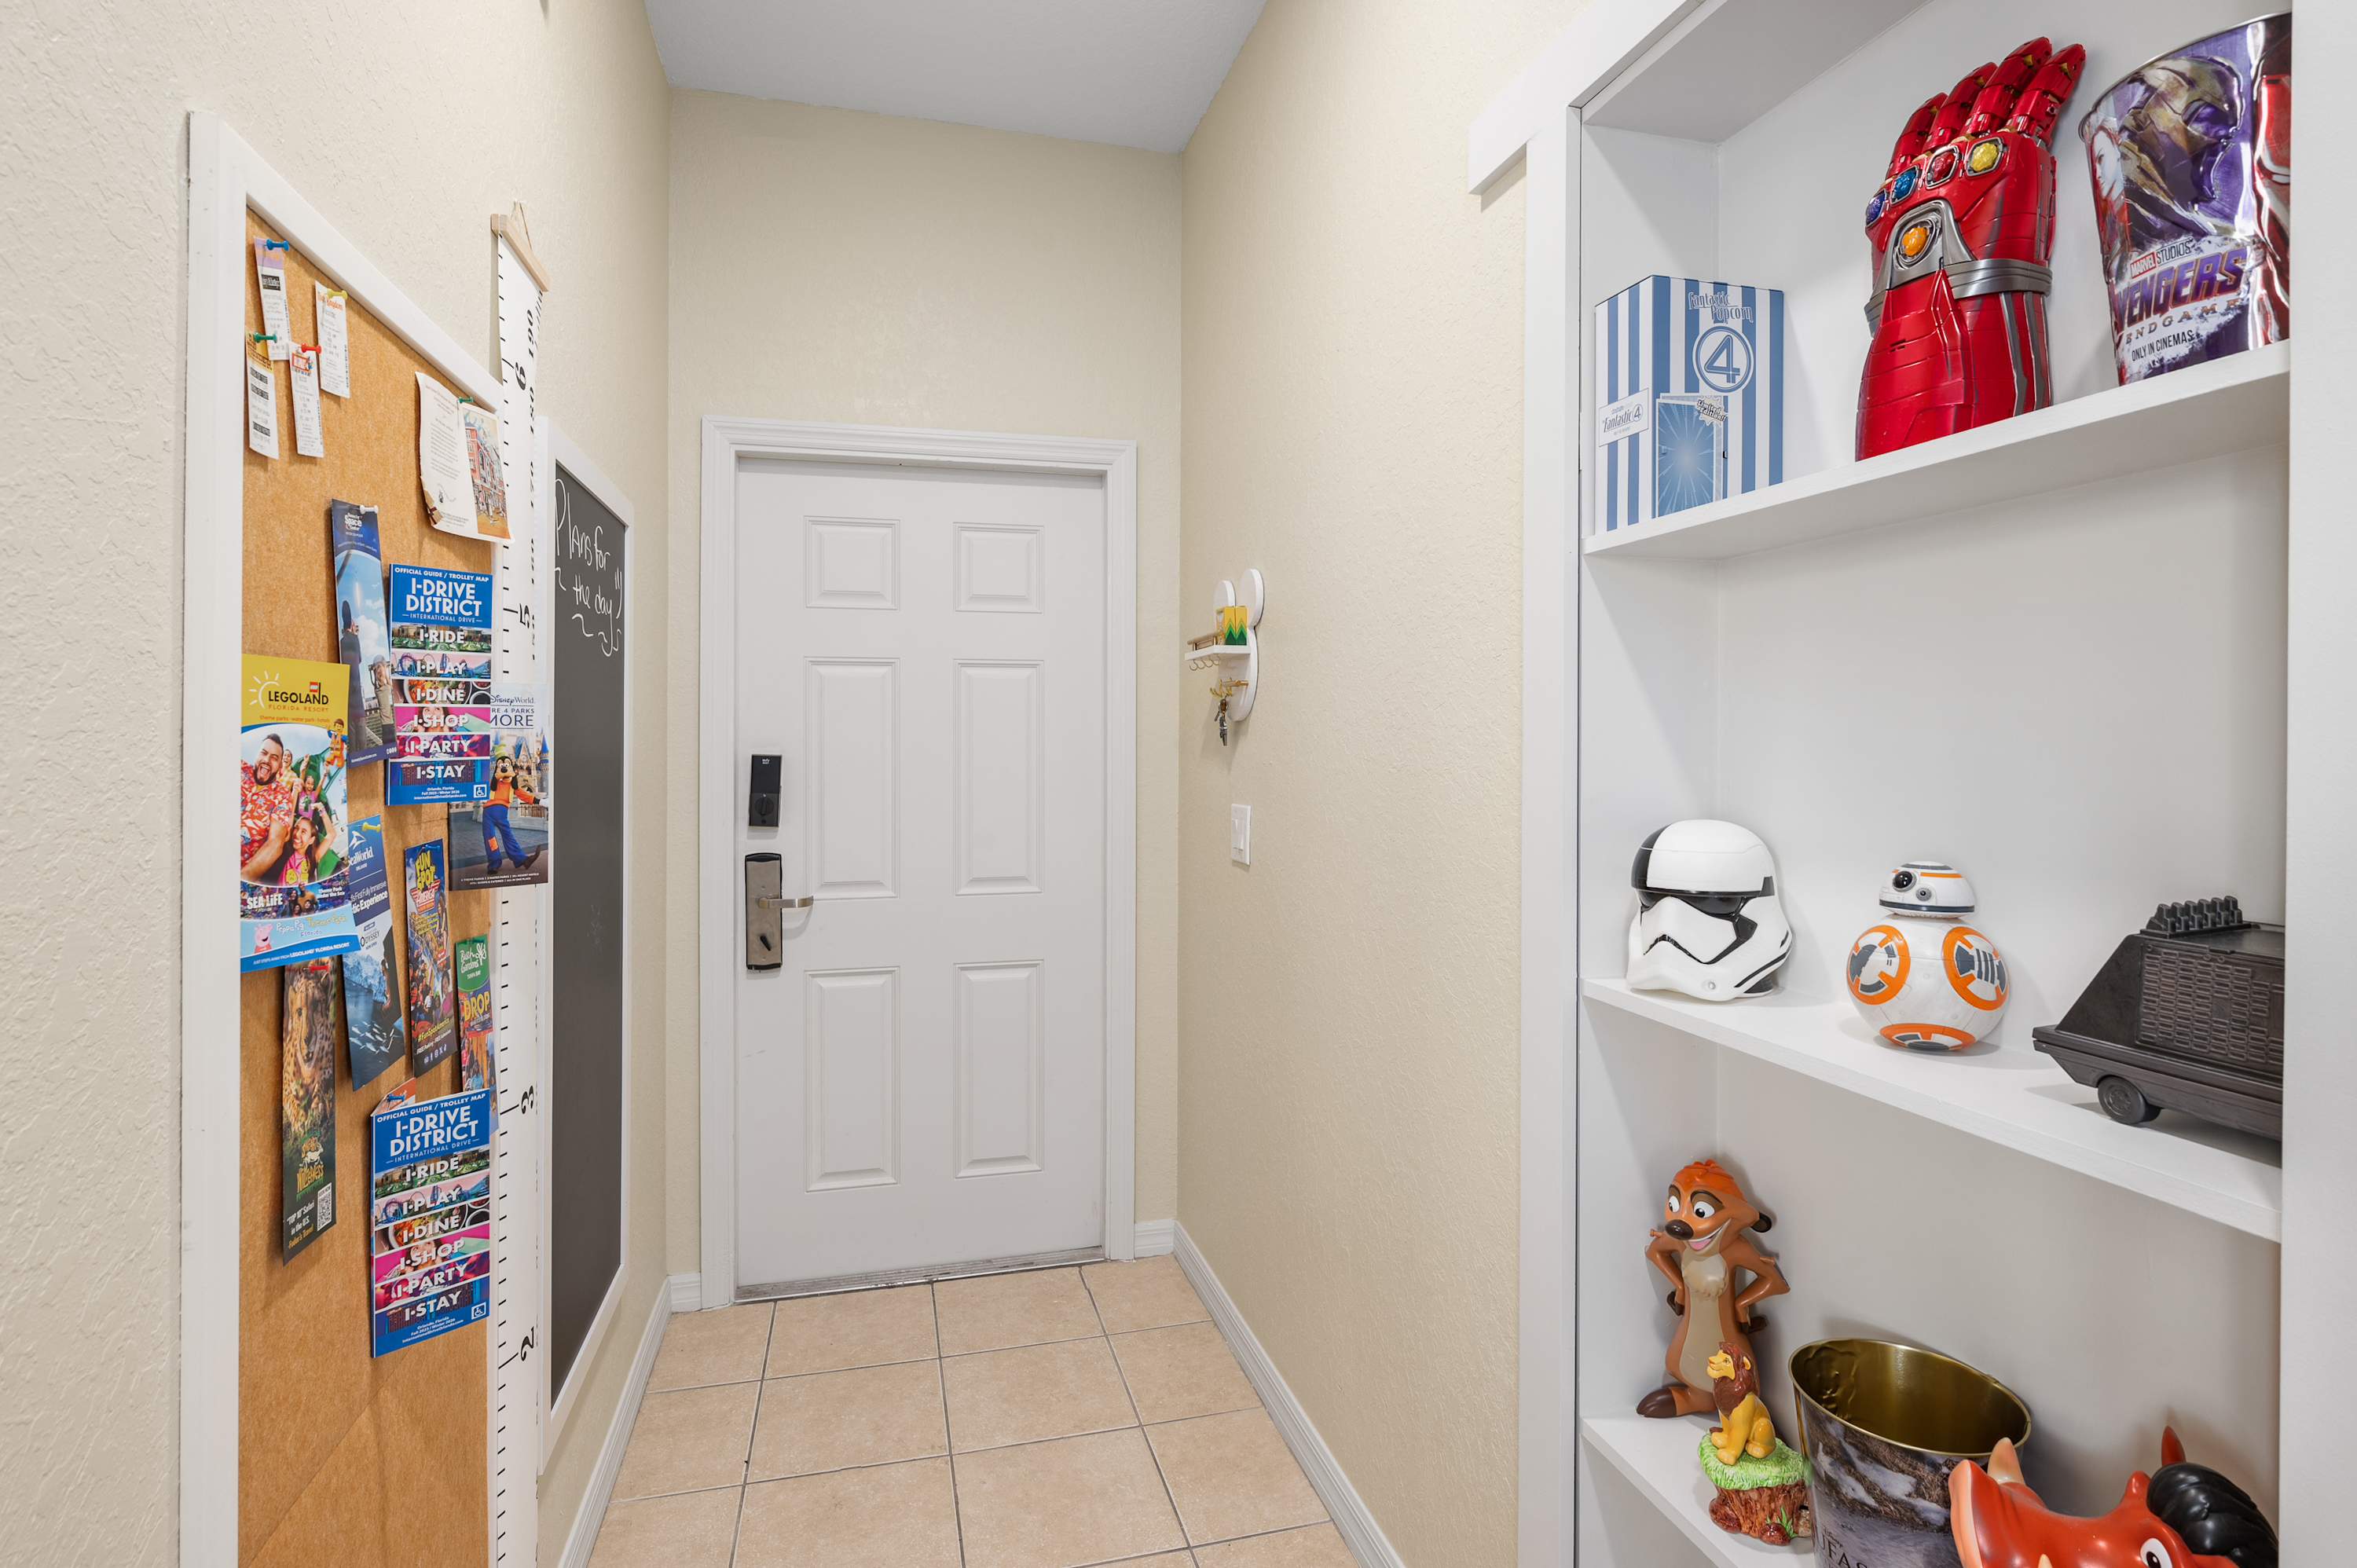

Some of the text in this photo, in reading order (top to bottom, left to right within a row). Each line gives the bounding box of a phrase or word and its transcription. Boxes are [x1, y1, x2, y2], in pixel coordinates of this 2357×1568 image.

[2131, 240, 2191, 277] MARVEL STUDIOS
[2125, 298, 2242, 345] ENDGAME
[1704, 335, 1740, 383] 4
[2132, 330, 2194, 361] ONLY IN CINEMAS
[515, 362, 526, 390] 6
[594, 526, 610, 571] for
[411, 577, 476, 600] I-DRIVE
[405, 594, 482, 617] DISTRICT
[409, 614, 456, 622] INTERNATIONAL
[519, 603, 530, 628] 5
[573, 574, 613, 657] the day
[268, 689, 329, 705] LEGOLAND
[415, 850, 431, 877] FUN
[417, 866, 436, 892] SPOT
[247, 896, 264, 910] SEA
[360, 890, 388, 910] Experience
[361, 930, 380, 947] ODYSSEY
[464, 991, 490, 1022] DROP
[376, 1110, 409, 1123] OFFICIAL
[409, 1105, 433, 1115] GUIDE
[440, 1097, 469, 1108] TROLLEY
[471, 1093, 486, 1101] MAP
[522, 1085, 534, 1115] 3
[395, 1105, 471, 1138] I-DRIVE
[390, 1119, 478, 1157] DISTRICT
[394, 1139, 471, 1163] INTERNATIONAL DRIVE
[520, 1326, 534, 1361] 2
[1816, 1534, 1868, 1568] UFA
